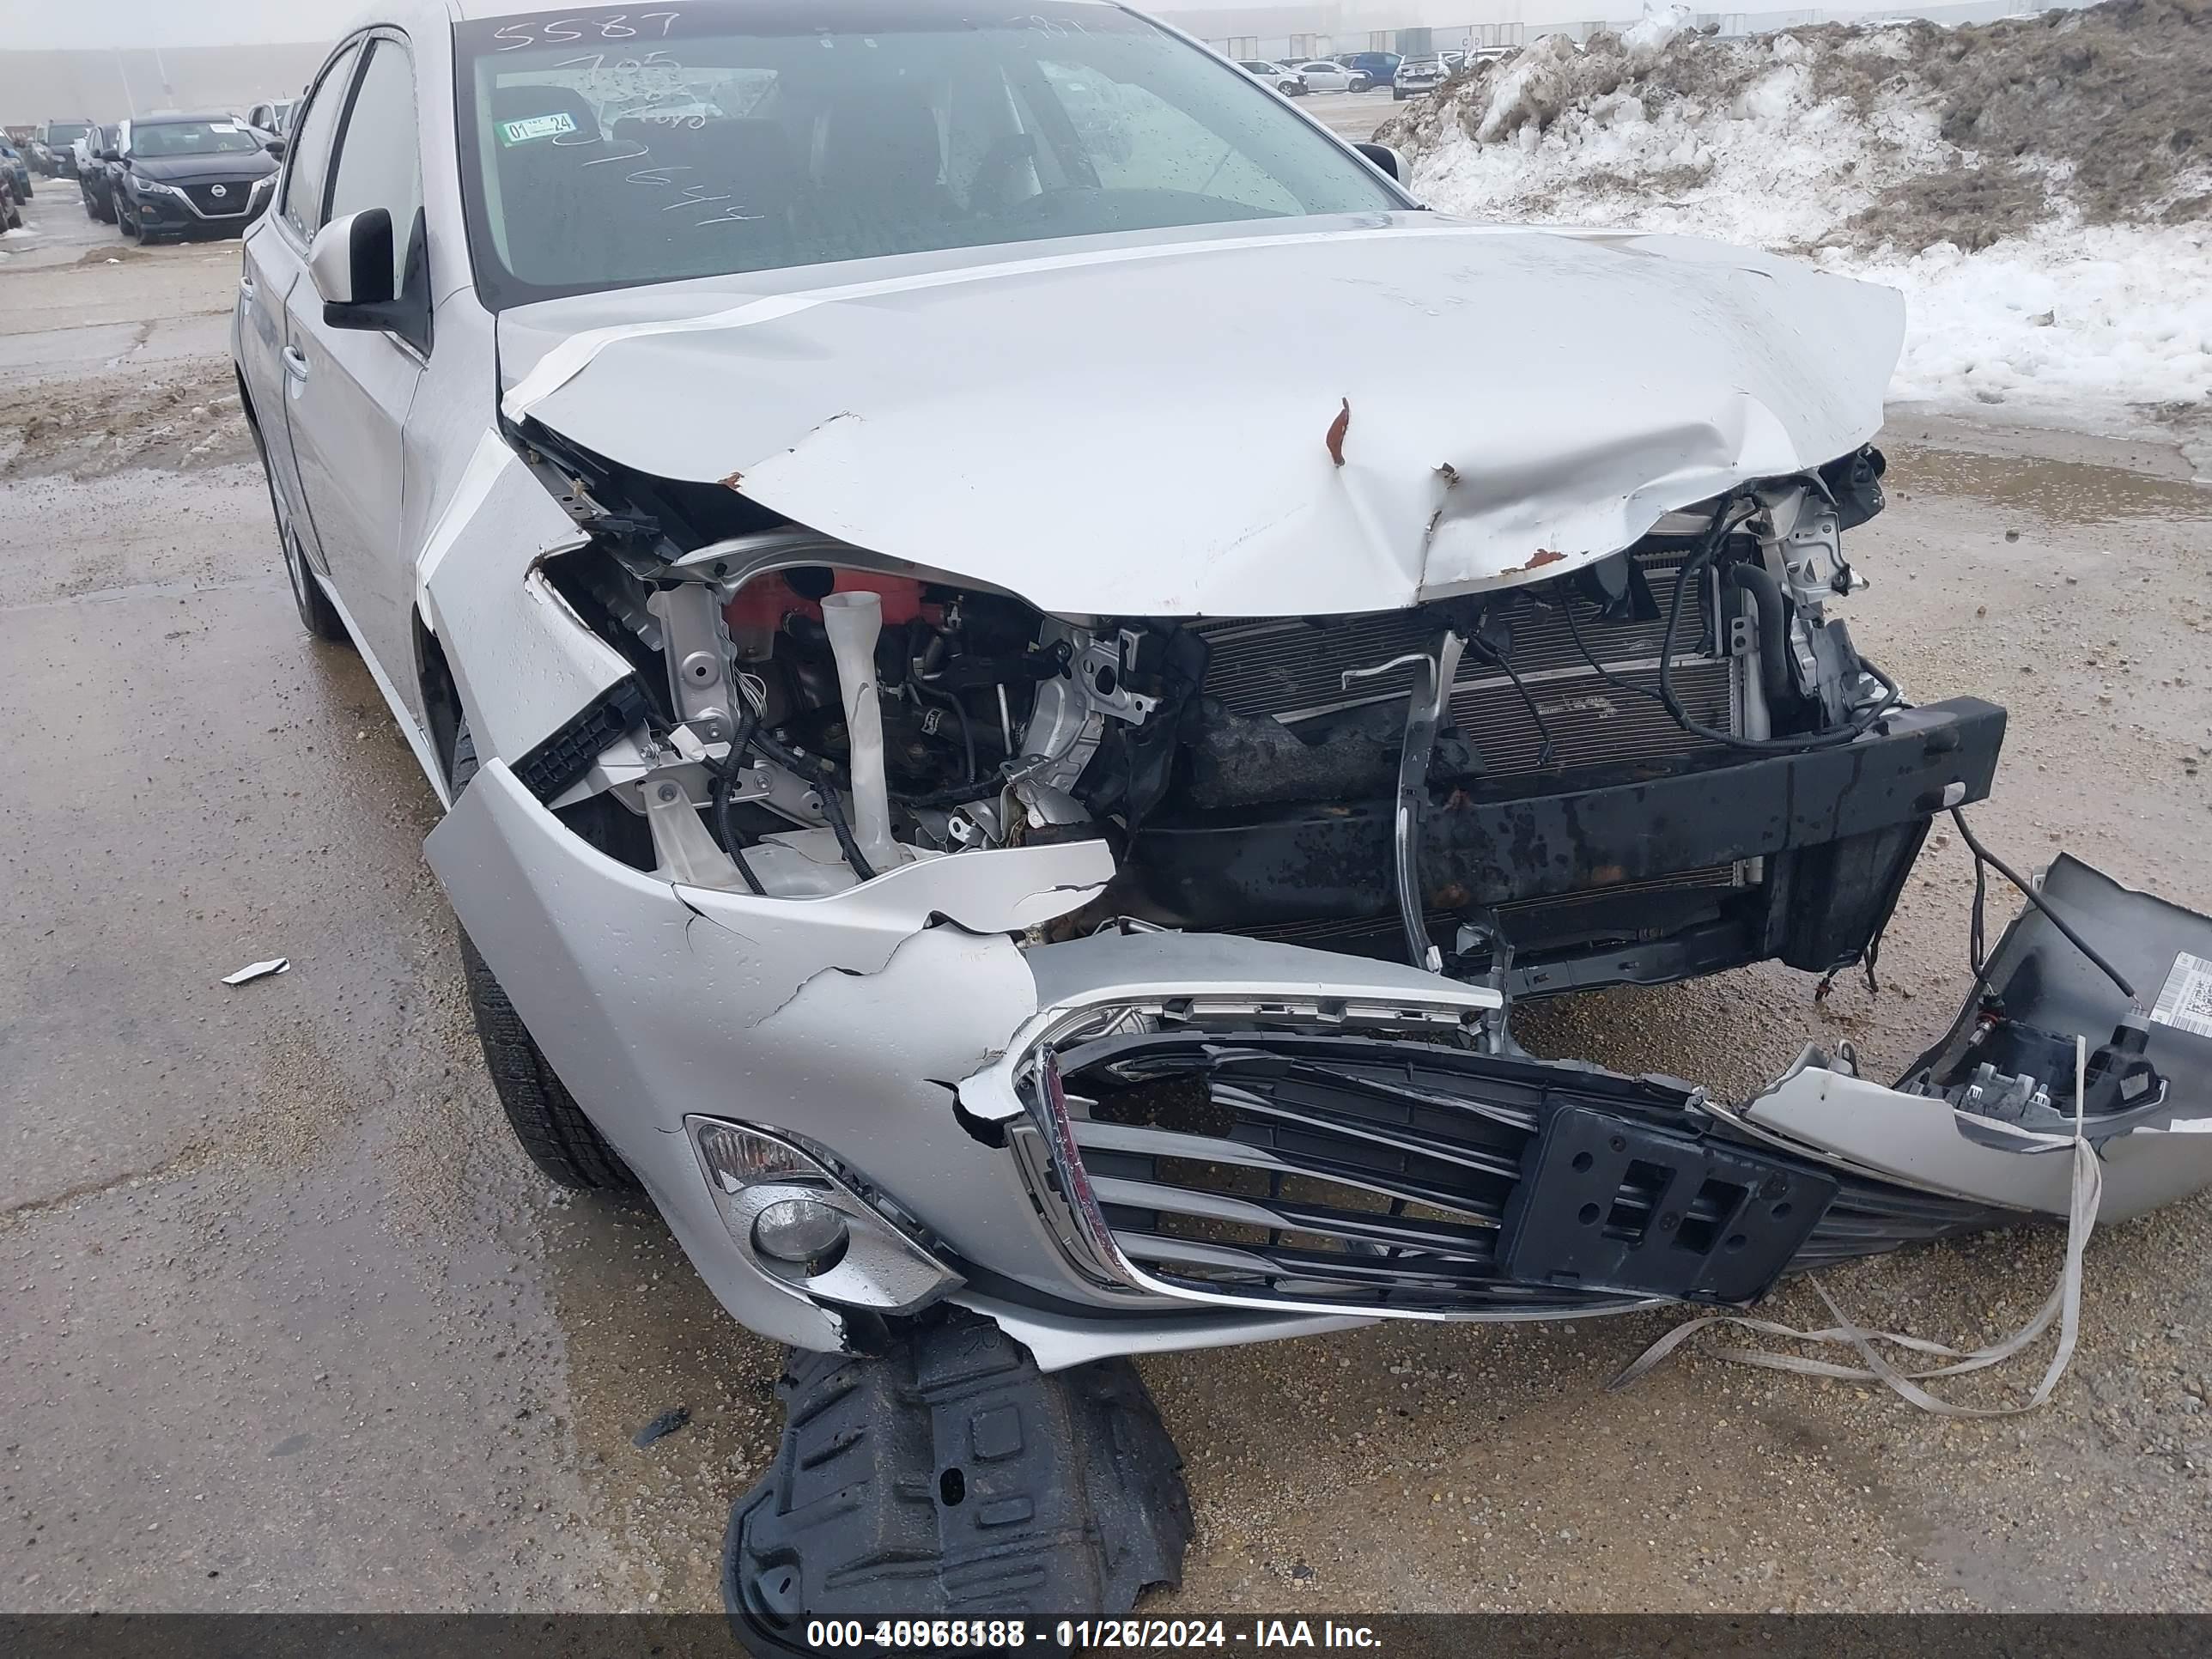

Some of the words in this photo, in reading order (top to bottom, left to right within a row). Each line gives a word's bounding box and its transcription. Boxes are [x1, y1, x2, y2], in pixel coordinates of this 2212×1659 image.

[494, 12, 681, 51] 5587
[1462, 38, 1468, 47] C
[508, 124, 530, 139] 01
[550, 115, 571, 131] 24
